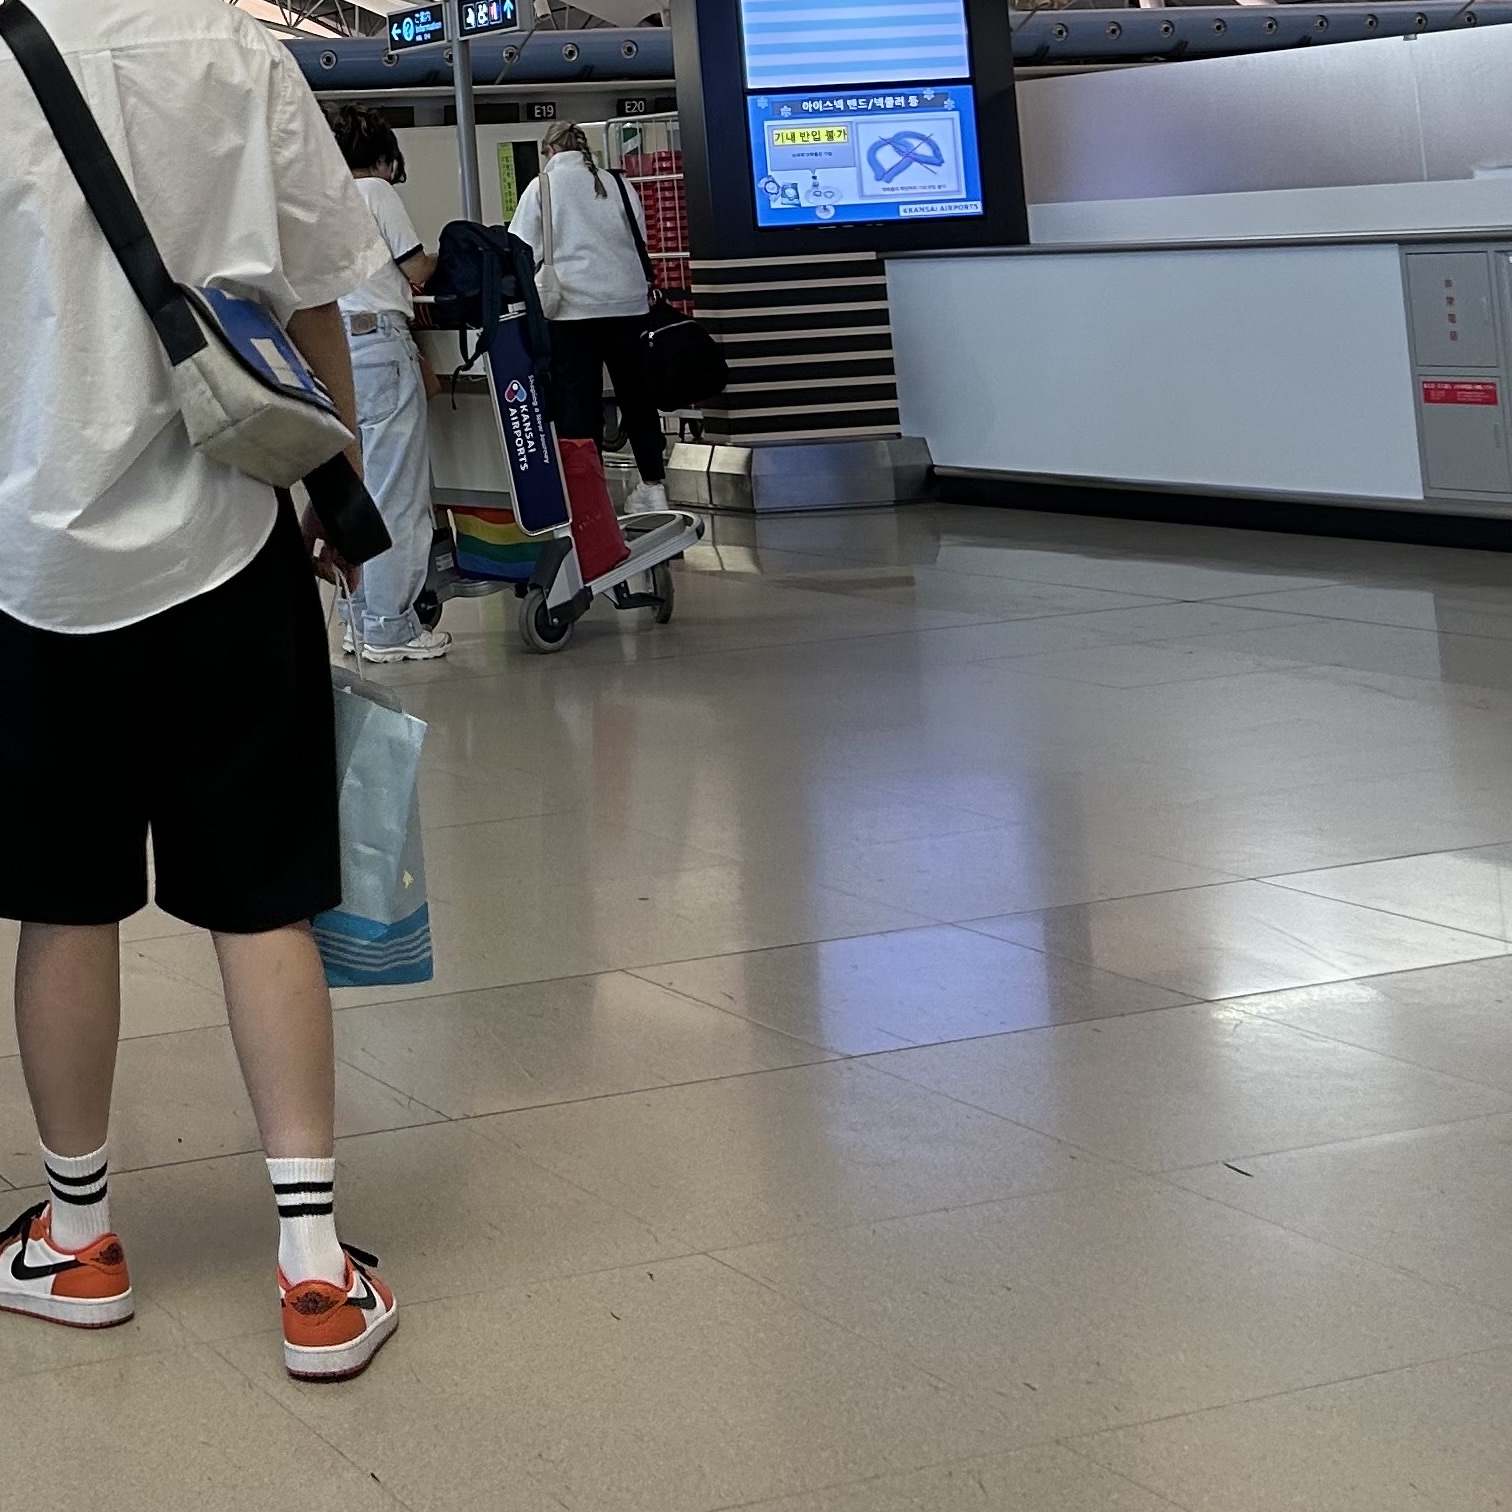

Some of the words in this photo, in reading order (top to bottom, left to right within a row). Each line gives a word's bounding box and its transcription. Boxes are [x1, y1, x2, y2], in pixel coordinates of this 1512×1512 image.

[535, 105, 554, 118] E19
[625, 101, 645, 113] E20
[775, 131, 796, 143] 기내
[799, 130, 821, 142] 반입
[519, 404, 537, 453] KANSAI
[508, 407, 529, 471] AIRPORTS
